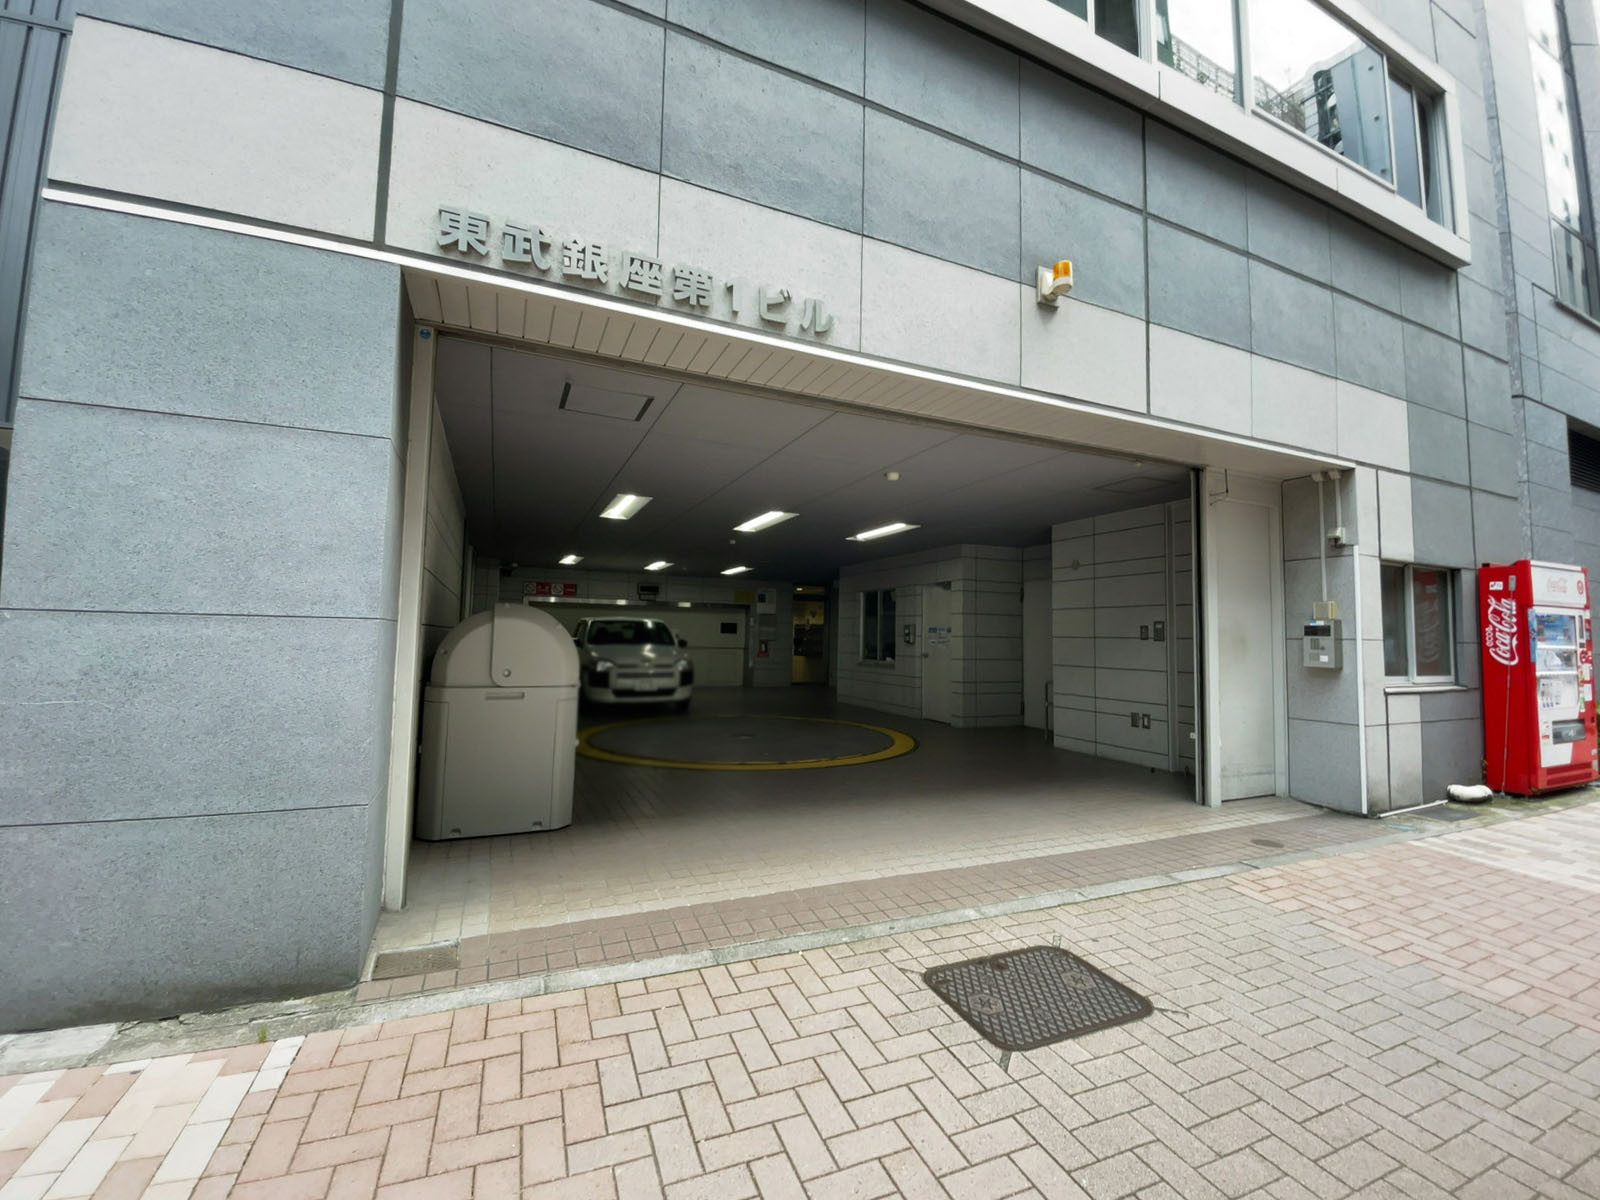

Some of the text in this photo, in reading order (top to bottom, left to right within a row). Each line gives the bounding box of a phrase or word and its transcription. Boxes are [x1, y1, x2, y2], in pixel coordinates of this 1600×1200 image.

[437, 207, 834, 334] 東武銀座第1ビル
